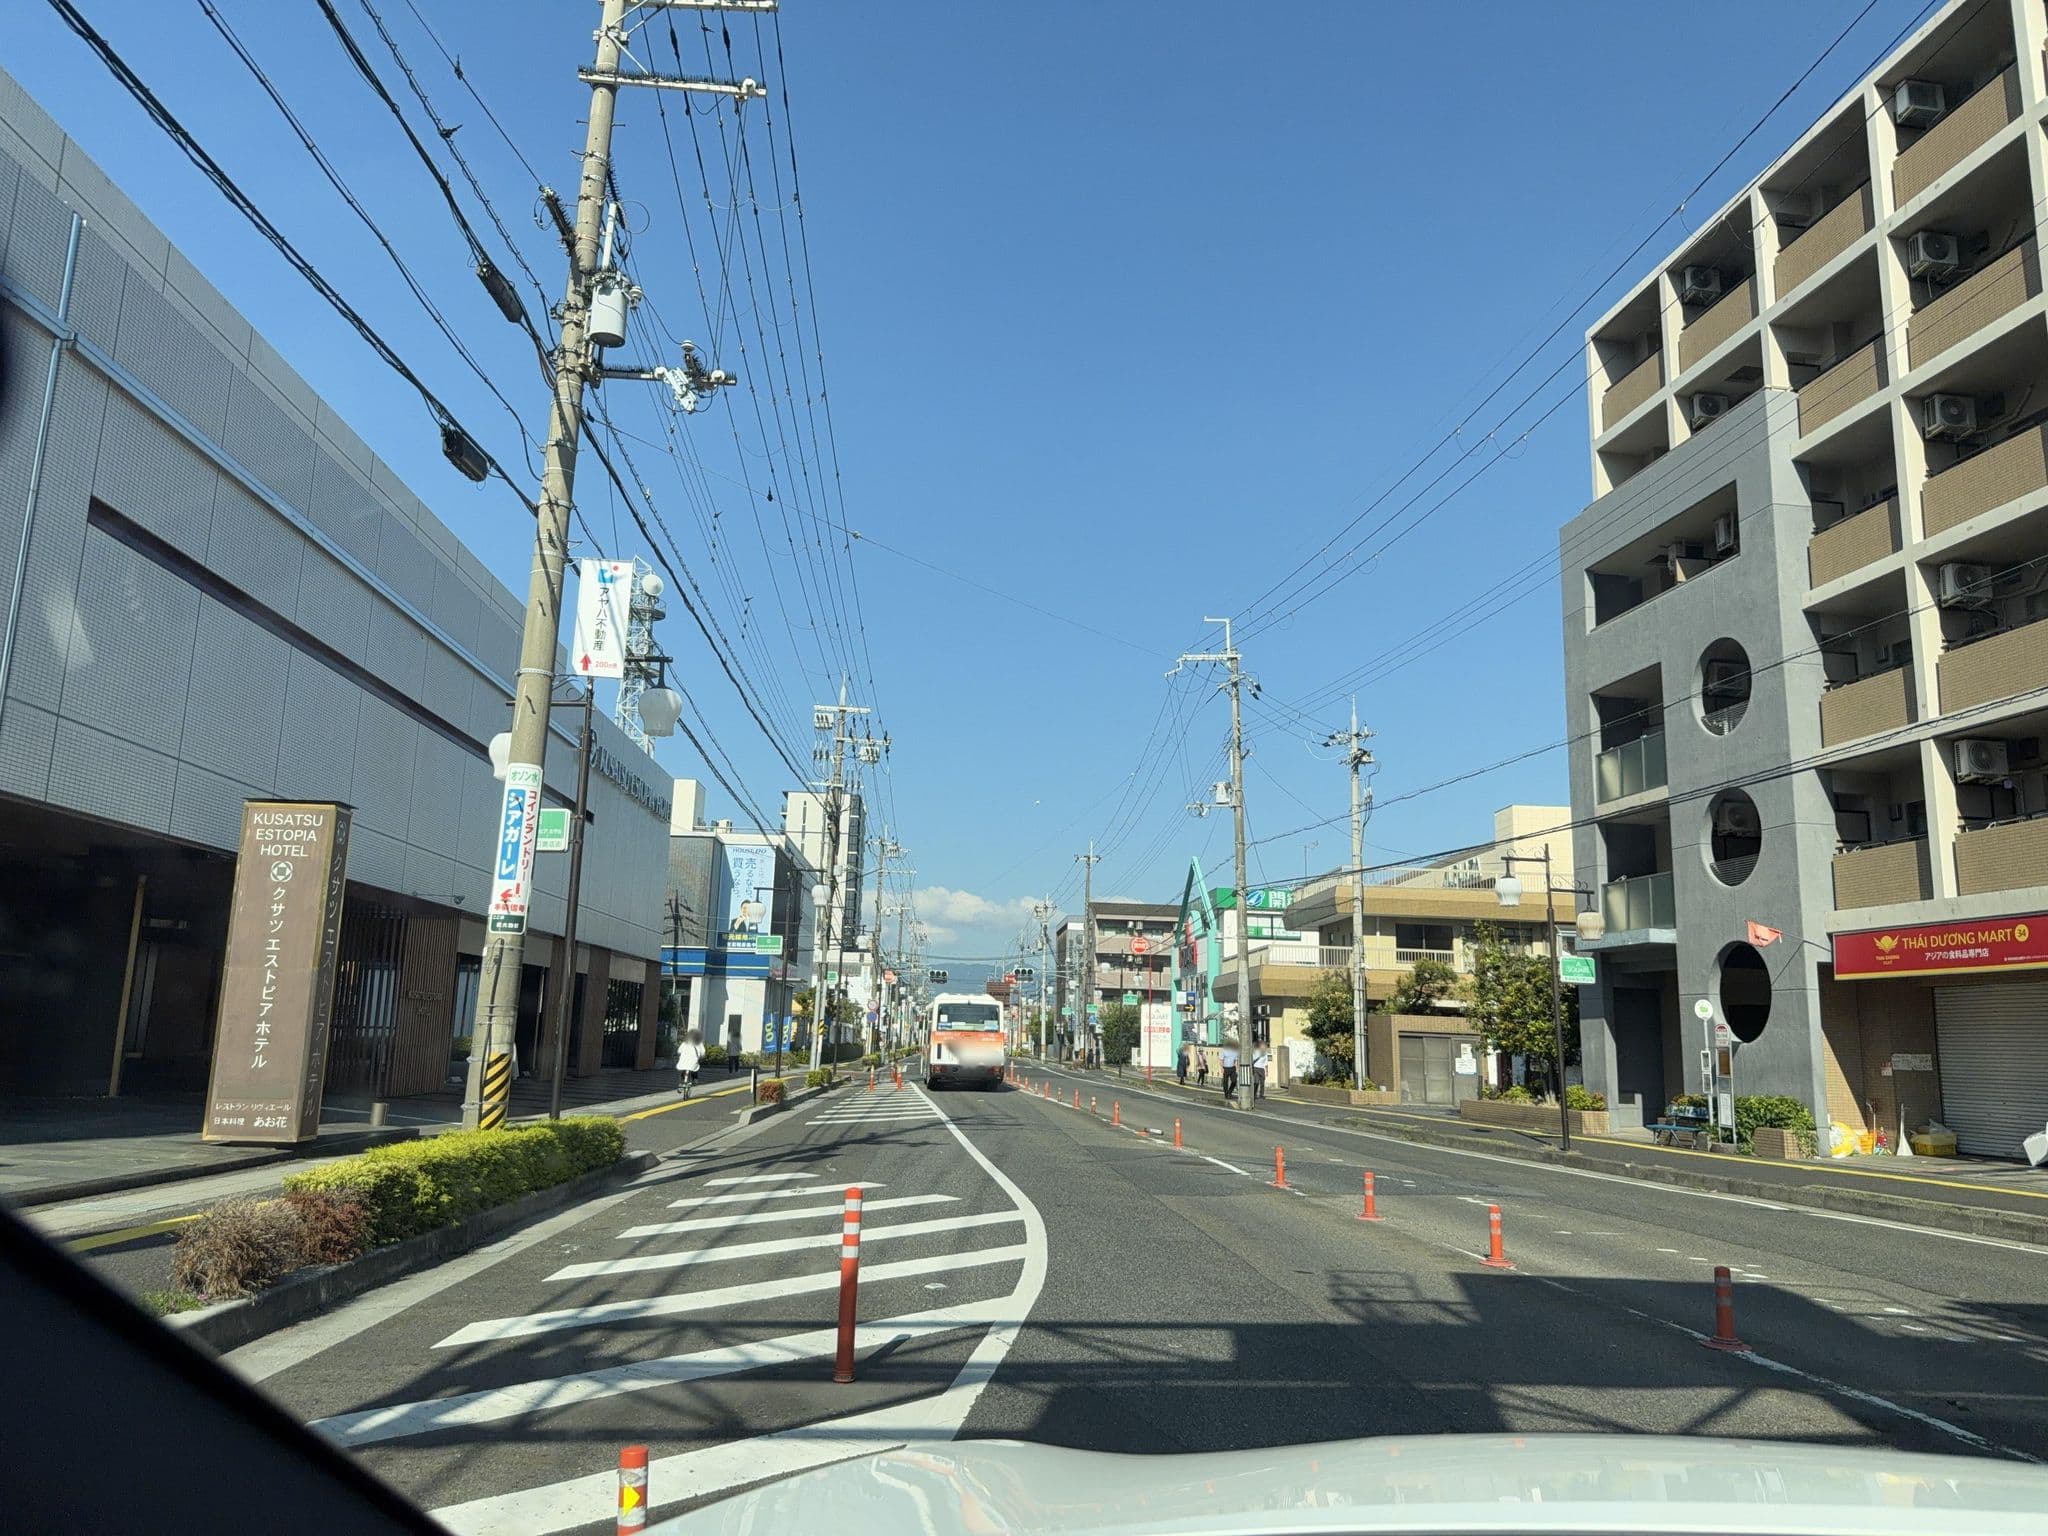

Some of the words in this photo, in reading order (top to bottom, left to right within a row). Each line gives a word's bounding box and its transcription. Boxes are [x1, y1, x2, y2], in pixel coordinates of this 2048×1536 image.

[592, 587, 610, 651] アヤハ不動産
[253, 812, 324, 827] KUSATSU
[255, 828, 317, 842] ESTOPIA
[521, 790, 538, 882] コインランドリー
[260, 844, 309, 857] HOTEL
[1902, 934, 1928, 950] THÁI
[1931, 932, 1976, 948] DƯƠNG
[1978, 929, 2012, 944] MART
[2016, 929, 2027, 938] 34
[1925, 948, 1990, 961] アジアの食料品専門店
[251, 886, 286, 1069] クサツエストピアホテル
[215, 1103, 249, 1111] レストラン
[251, 1103, 292, 1112] リヴィエール
[214, 1117, 245, 1126] 日本料理
[253, 1116, 289, 1128] あお花
